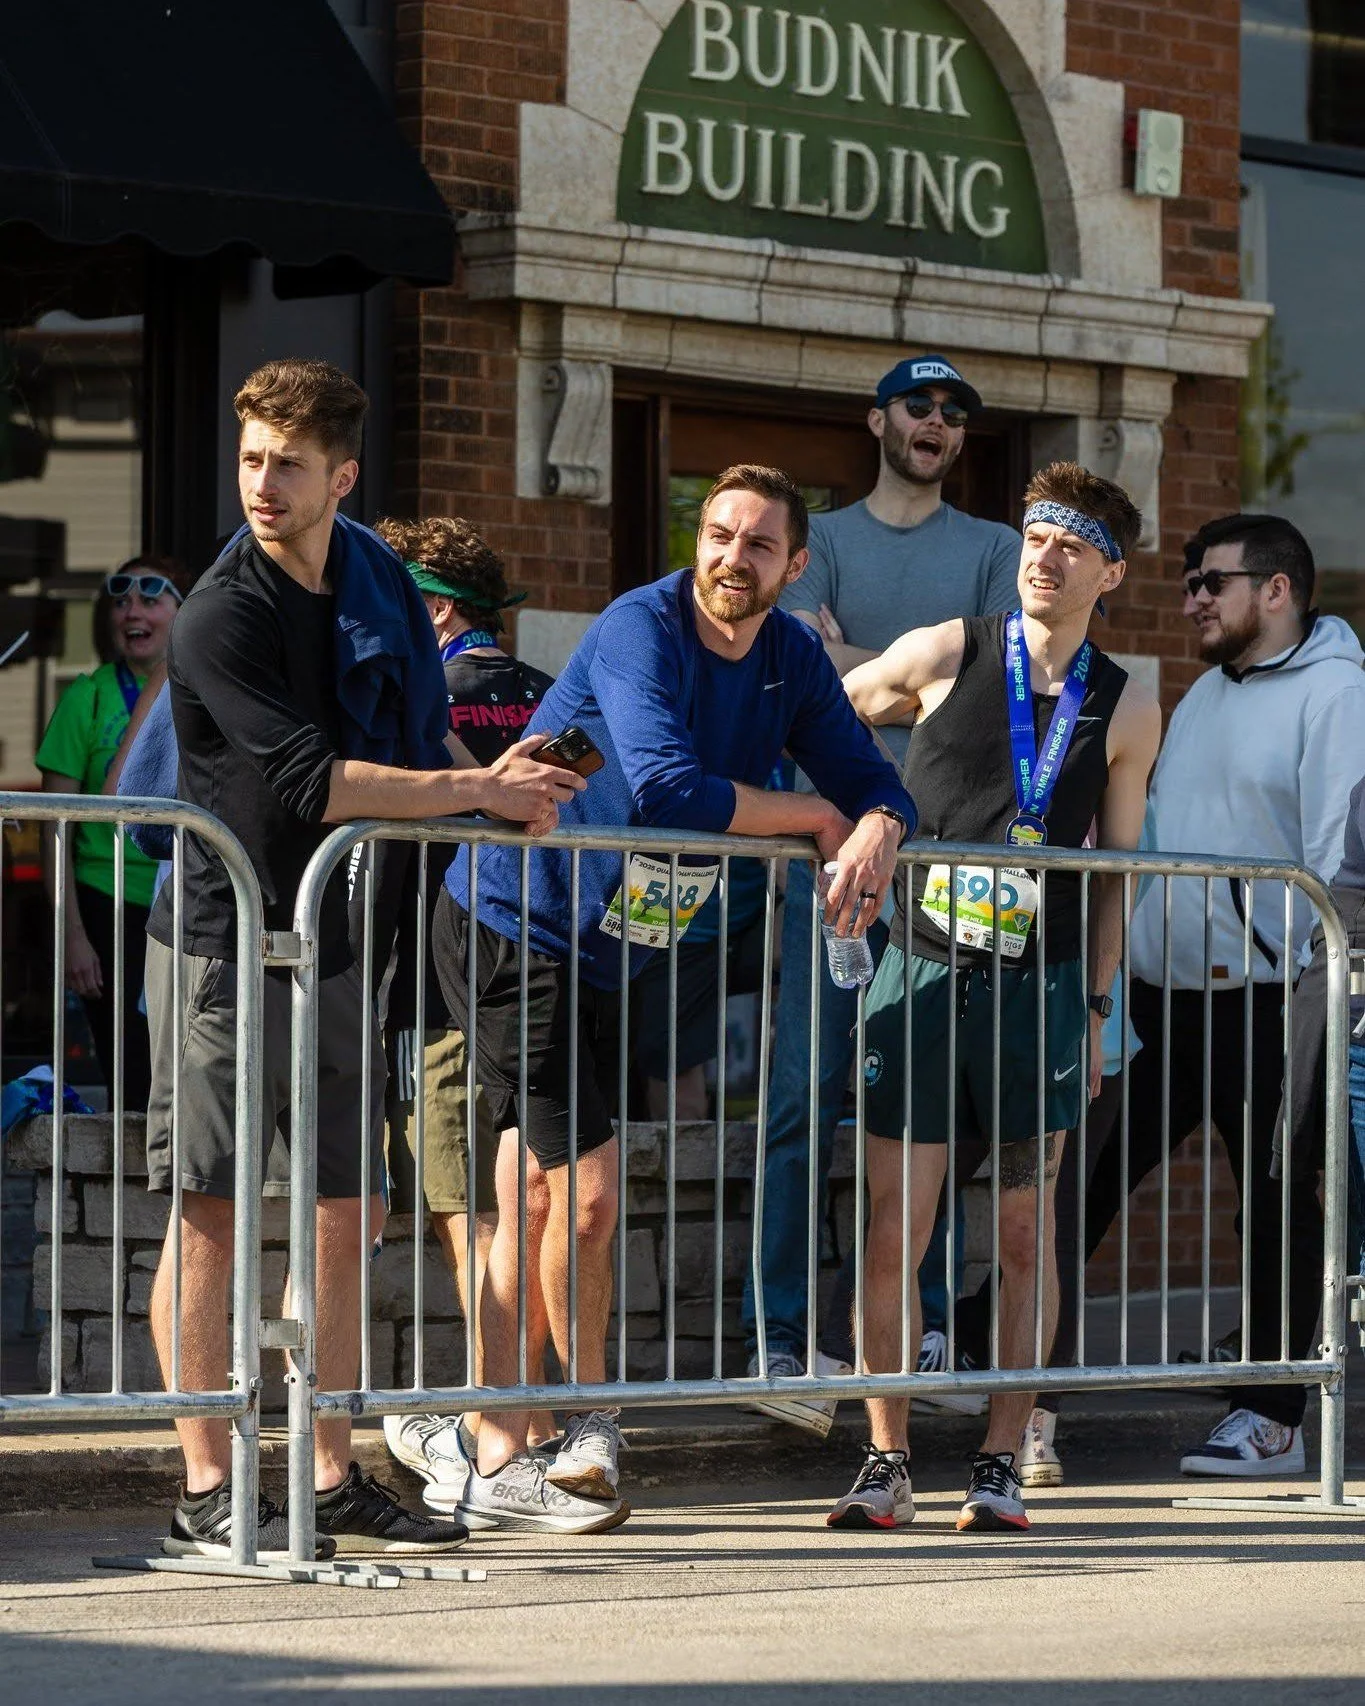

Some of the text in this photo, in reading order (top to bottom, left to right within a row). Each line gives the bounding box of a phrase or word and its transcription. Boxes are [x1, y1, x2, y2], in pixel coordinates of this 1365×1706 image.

[689, 0, 971, 118] BUDNIK
[641, 111, 1011, 239] BUILDING
[1013, 656, 1026, 702] FINISHER
[449, 702, 540, 729] FINISH
[1047, 717, 1068, 762] FINISHER
[1038, 764, 1053, 789] MILE
[1034, 784, 1045, 800] 10
[639, 861, 655, 871] 2025
[641, 880, 699, 910] 588
[944, 869, 1019, 912] 590
[605, 918, 622, 931] 588
[491, 1481, 572, 1507] BROOKS
